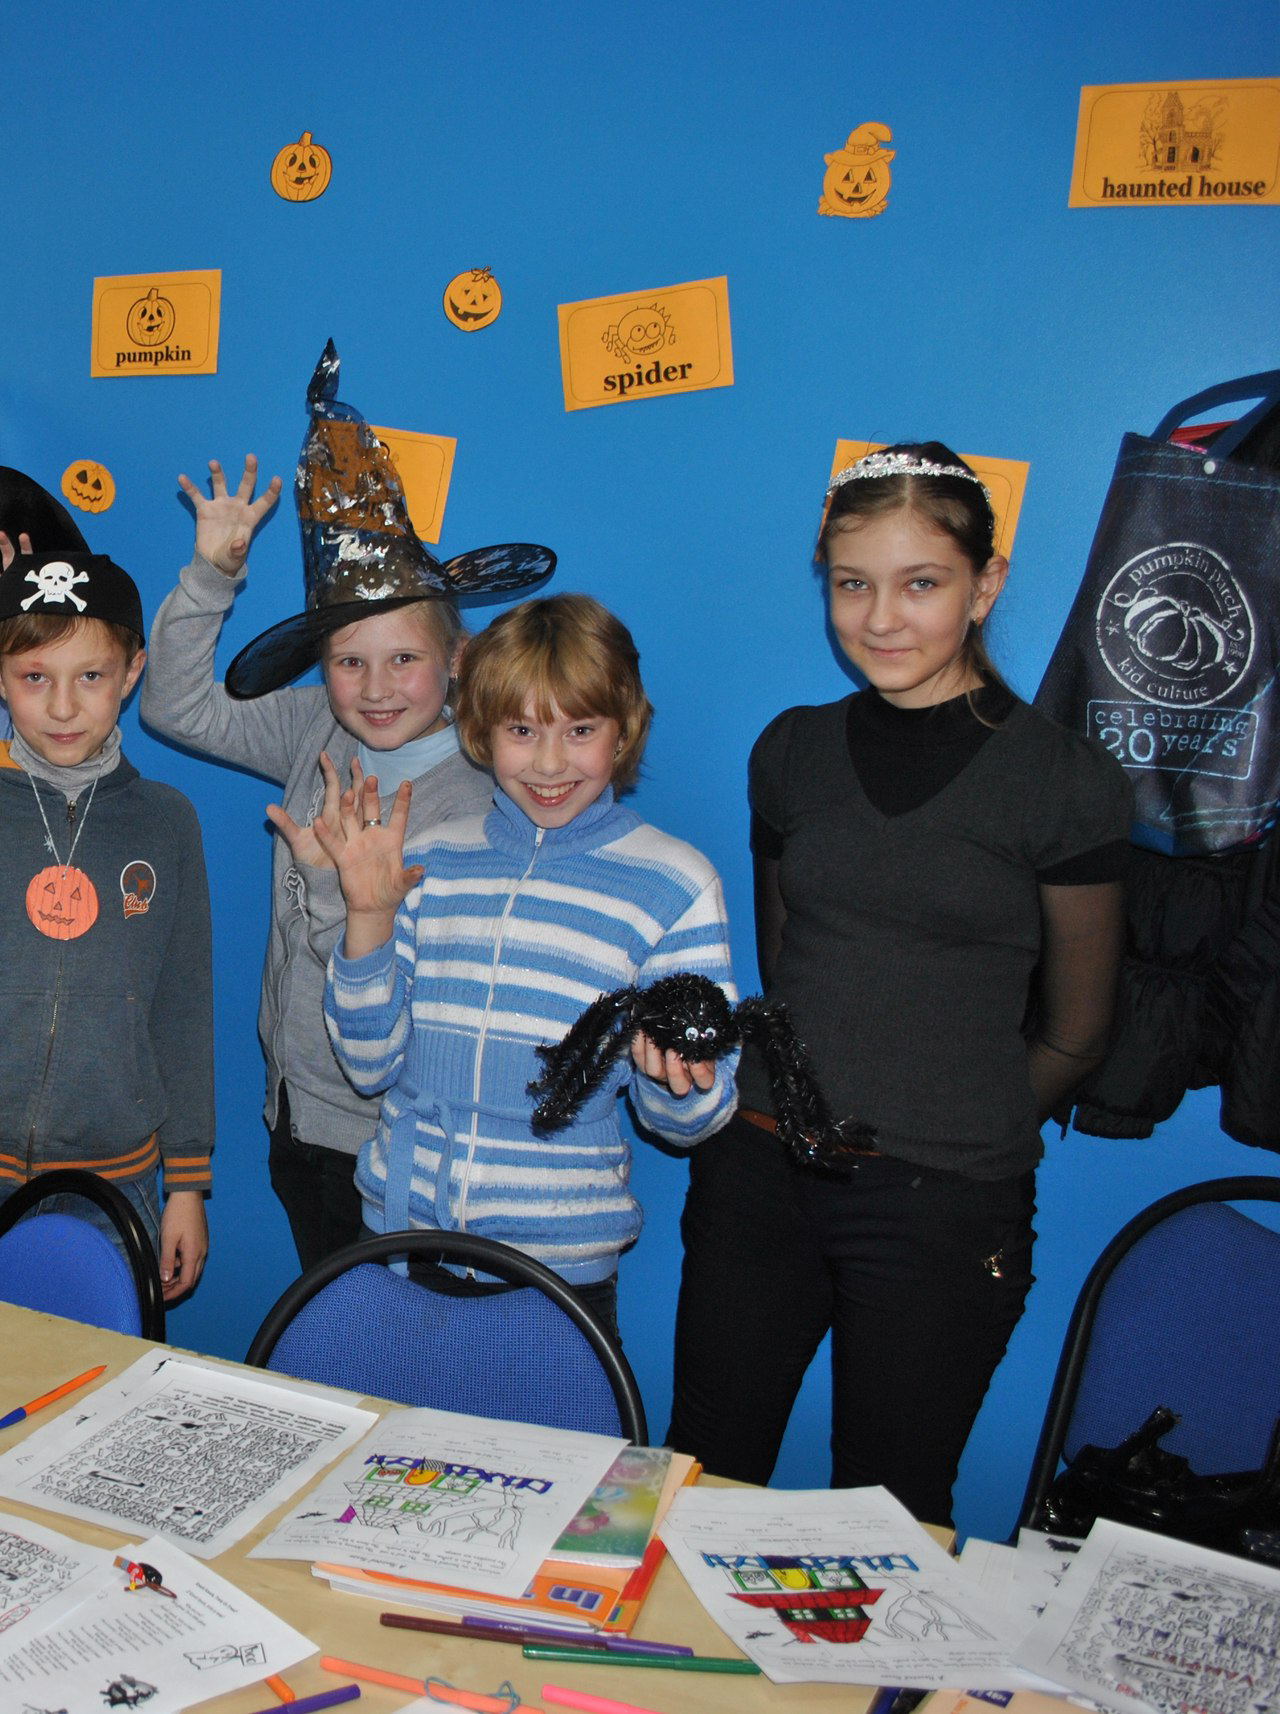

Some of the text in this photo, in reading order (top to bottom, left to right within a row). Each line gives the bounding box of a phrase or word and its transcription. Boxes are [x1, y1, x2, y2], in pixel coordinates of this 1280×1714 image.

[1101, 174, 1266, 199] haunted house
[115, 345, 192, 366] pumpkin
[603, 358, 693, 396] spider
[1128, 548, 1209, 586] pumpkin
[1116, 657, 1144, 685] kid
[1095, 708, 1249, 740] celebrating
[1099, 727, 1238, 763] 20 years
